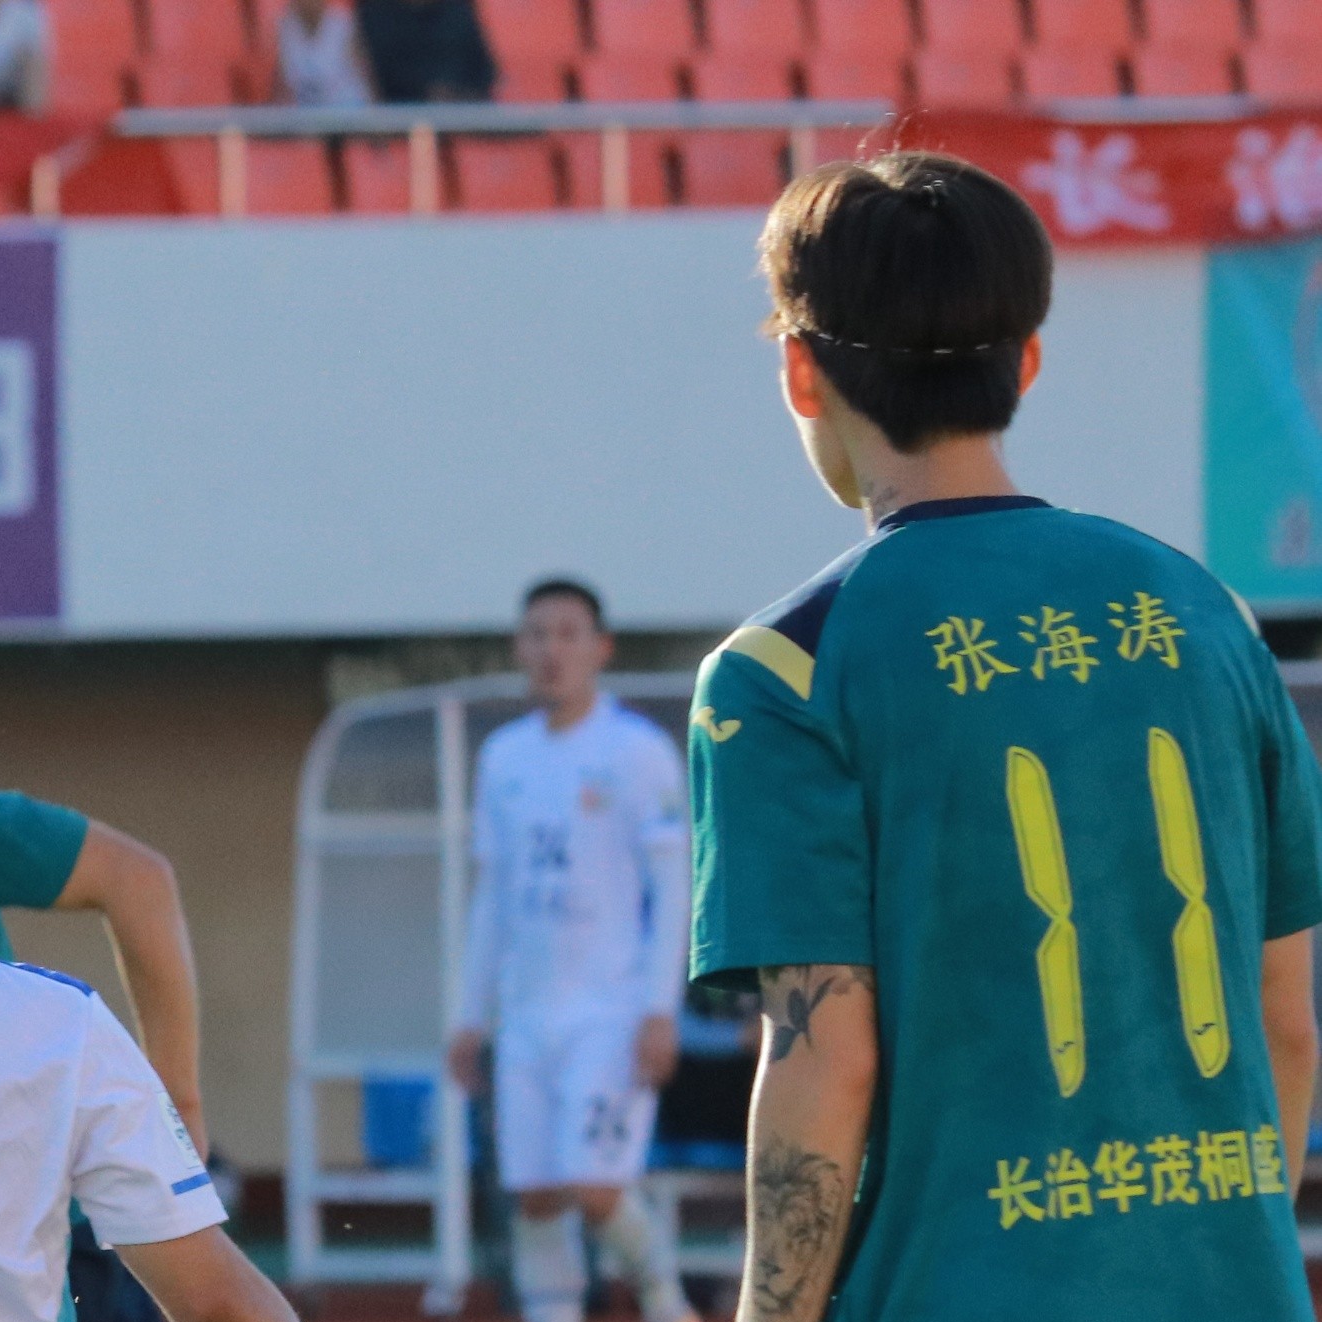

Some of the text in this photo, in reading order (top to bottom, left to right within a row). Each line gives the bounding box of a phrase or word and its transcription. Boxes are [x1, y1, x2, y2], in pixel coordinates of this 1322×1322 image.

[925, 591, 1185, 696] 张海涛
[1006, 727, 1231, 1098] 11
[988, 1124, 1287, 1230] 长治华茂桐盛
